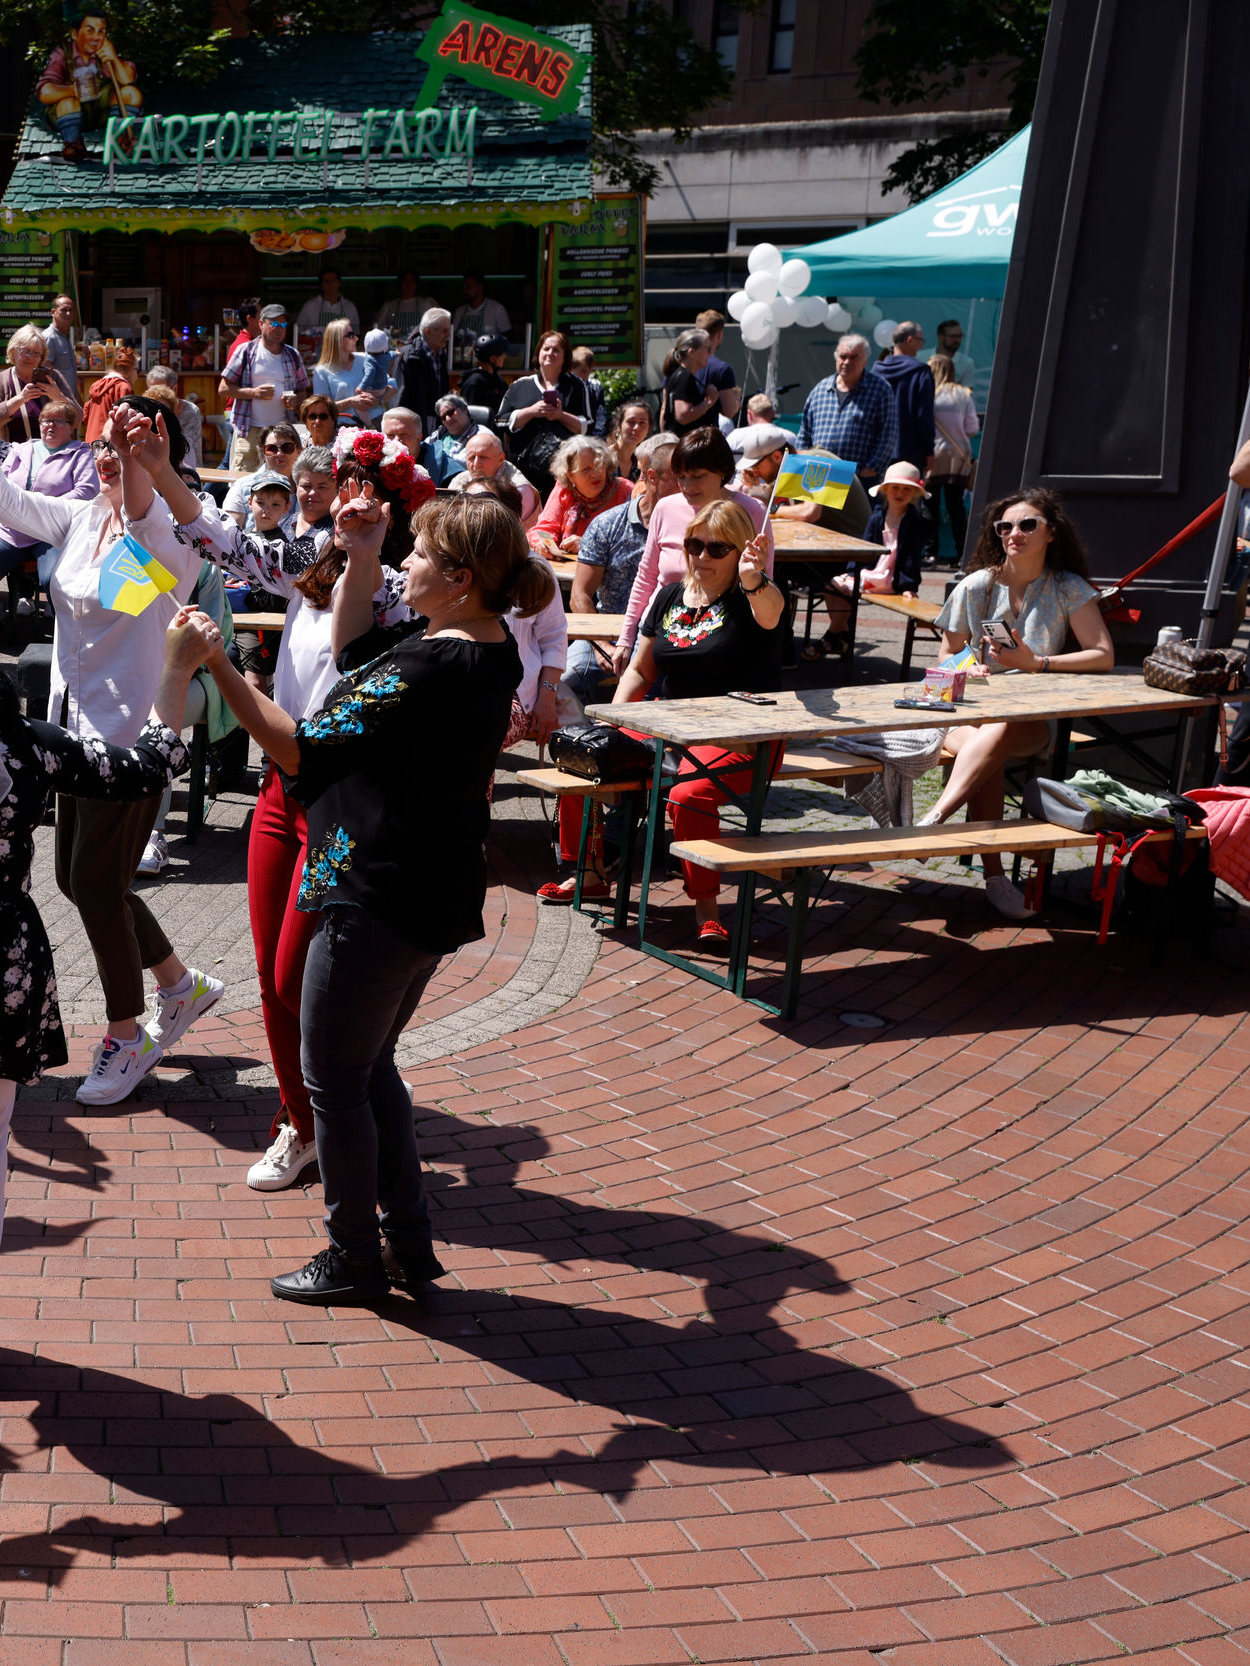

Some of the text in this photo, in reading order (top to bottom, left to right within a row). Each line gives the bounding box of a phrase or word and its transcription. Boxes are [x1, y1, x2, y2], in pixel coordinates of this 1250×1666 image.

[437, 20, 573, 99] ARENS
[103, 107, 478, 165] KARTOFFEL FARM
